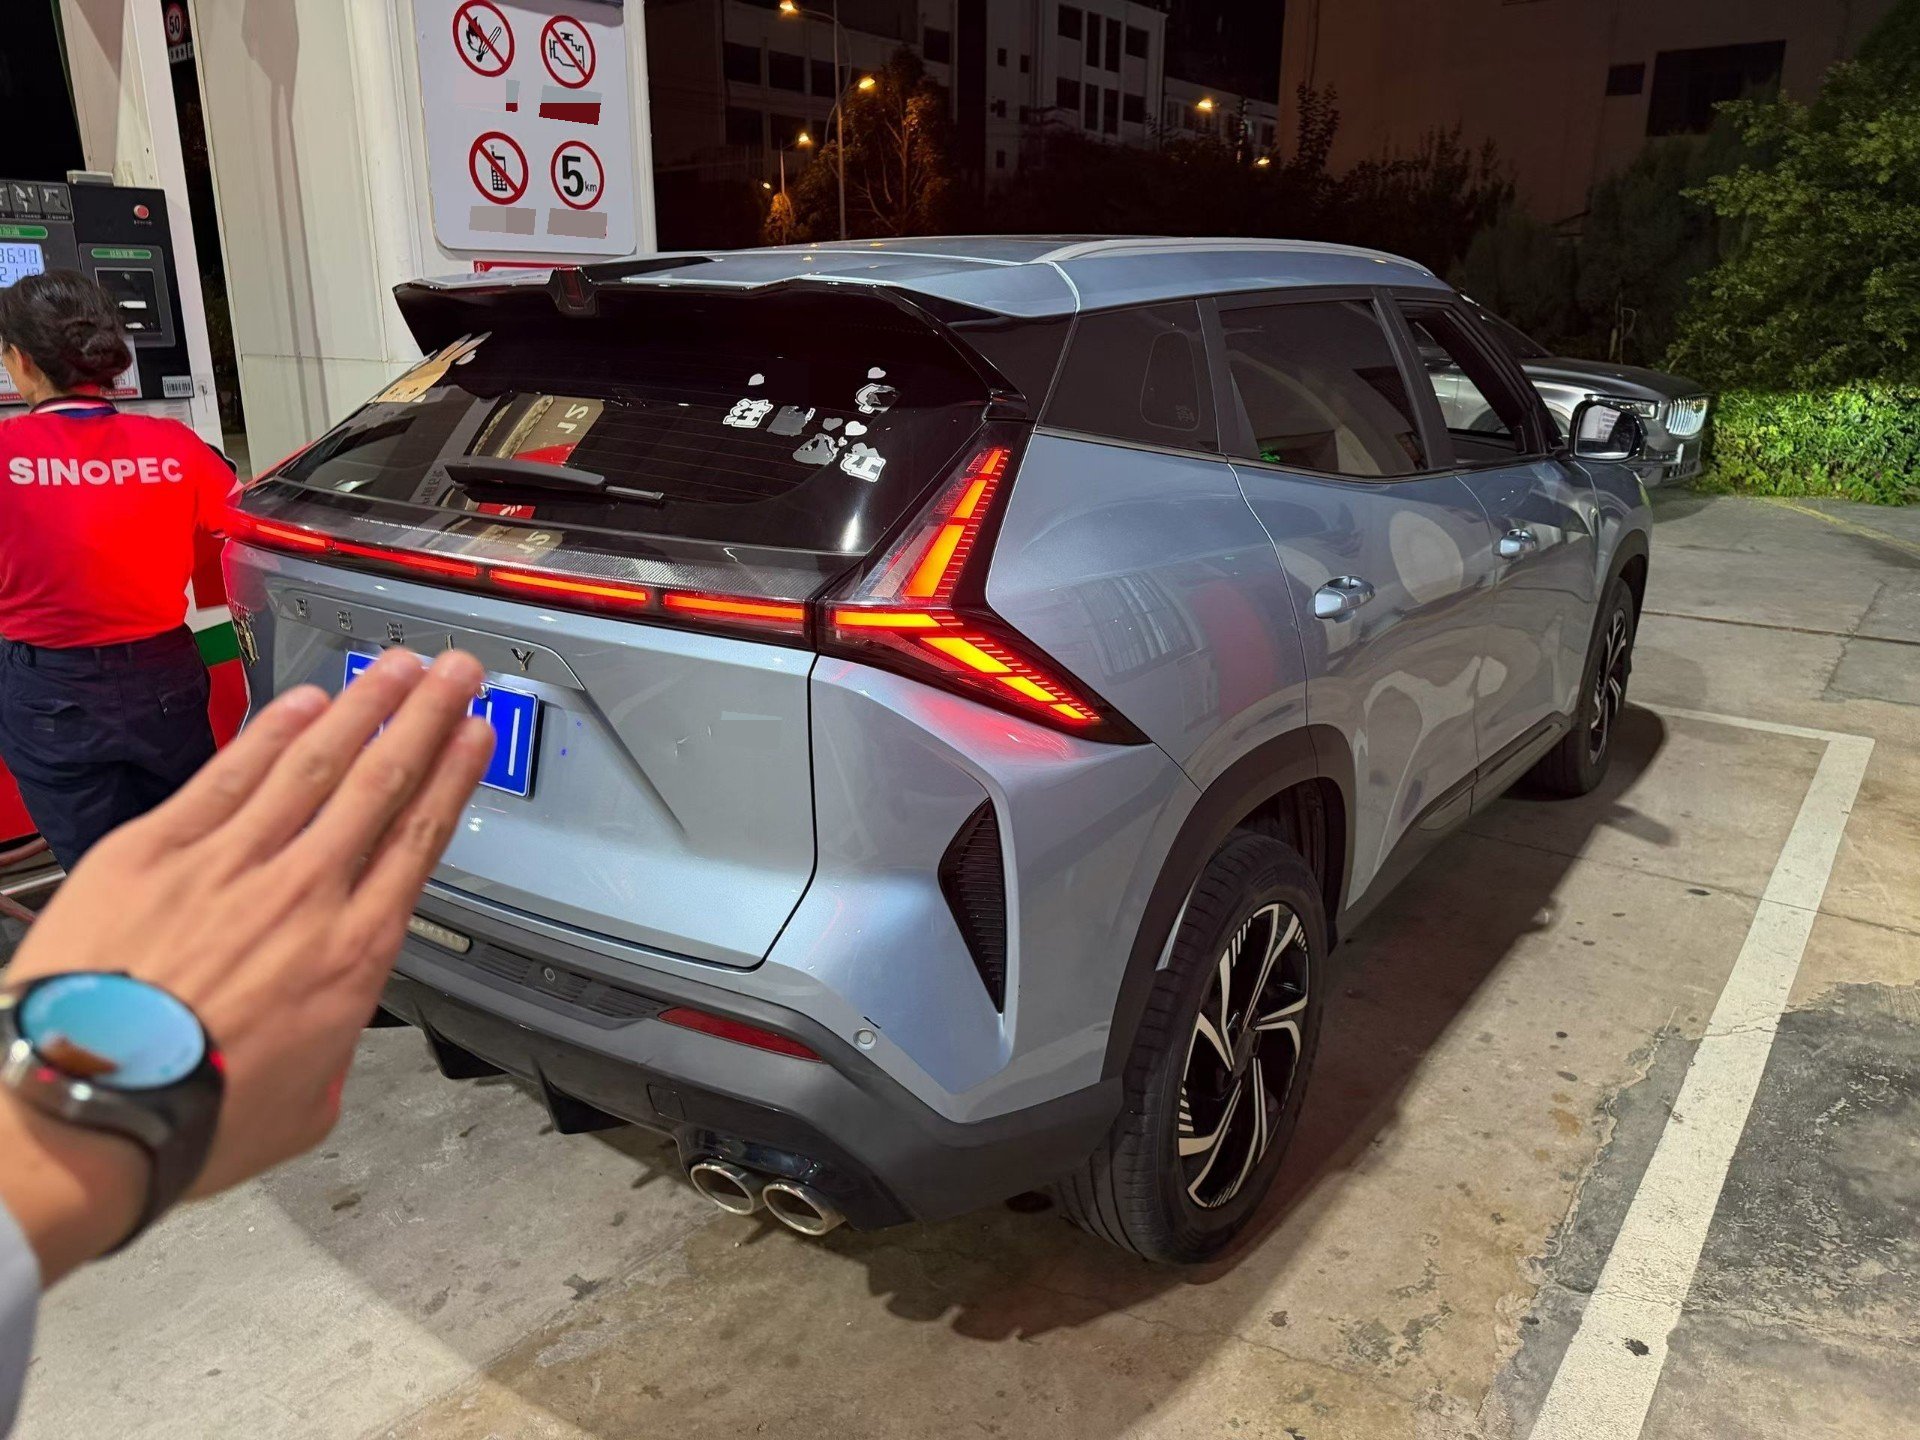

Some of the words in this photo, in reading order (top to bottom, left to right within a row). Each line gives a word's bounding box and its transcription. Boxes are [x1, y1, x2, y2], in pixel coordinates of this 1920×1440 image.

[562, 155, 584, 197] 5
[585, 181, 598, 192] km
[9, 456, 184, 486] SINOPEC
